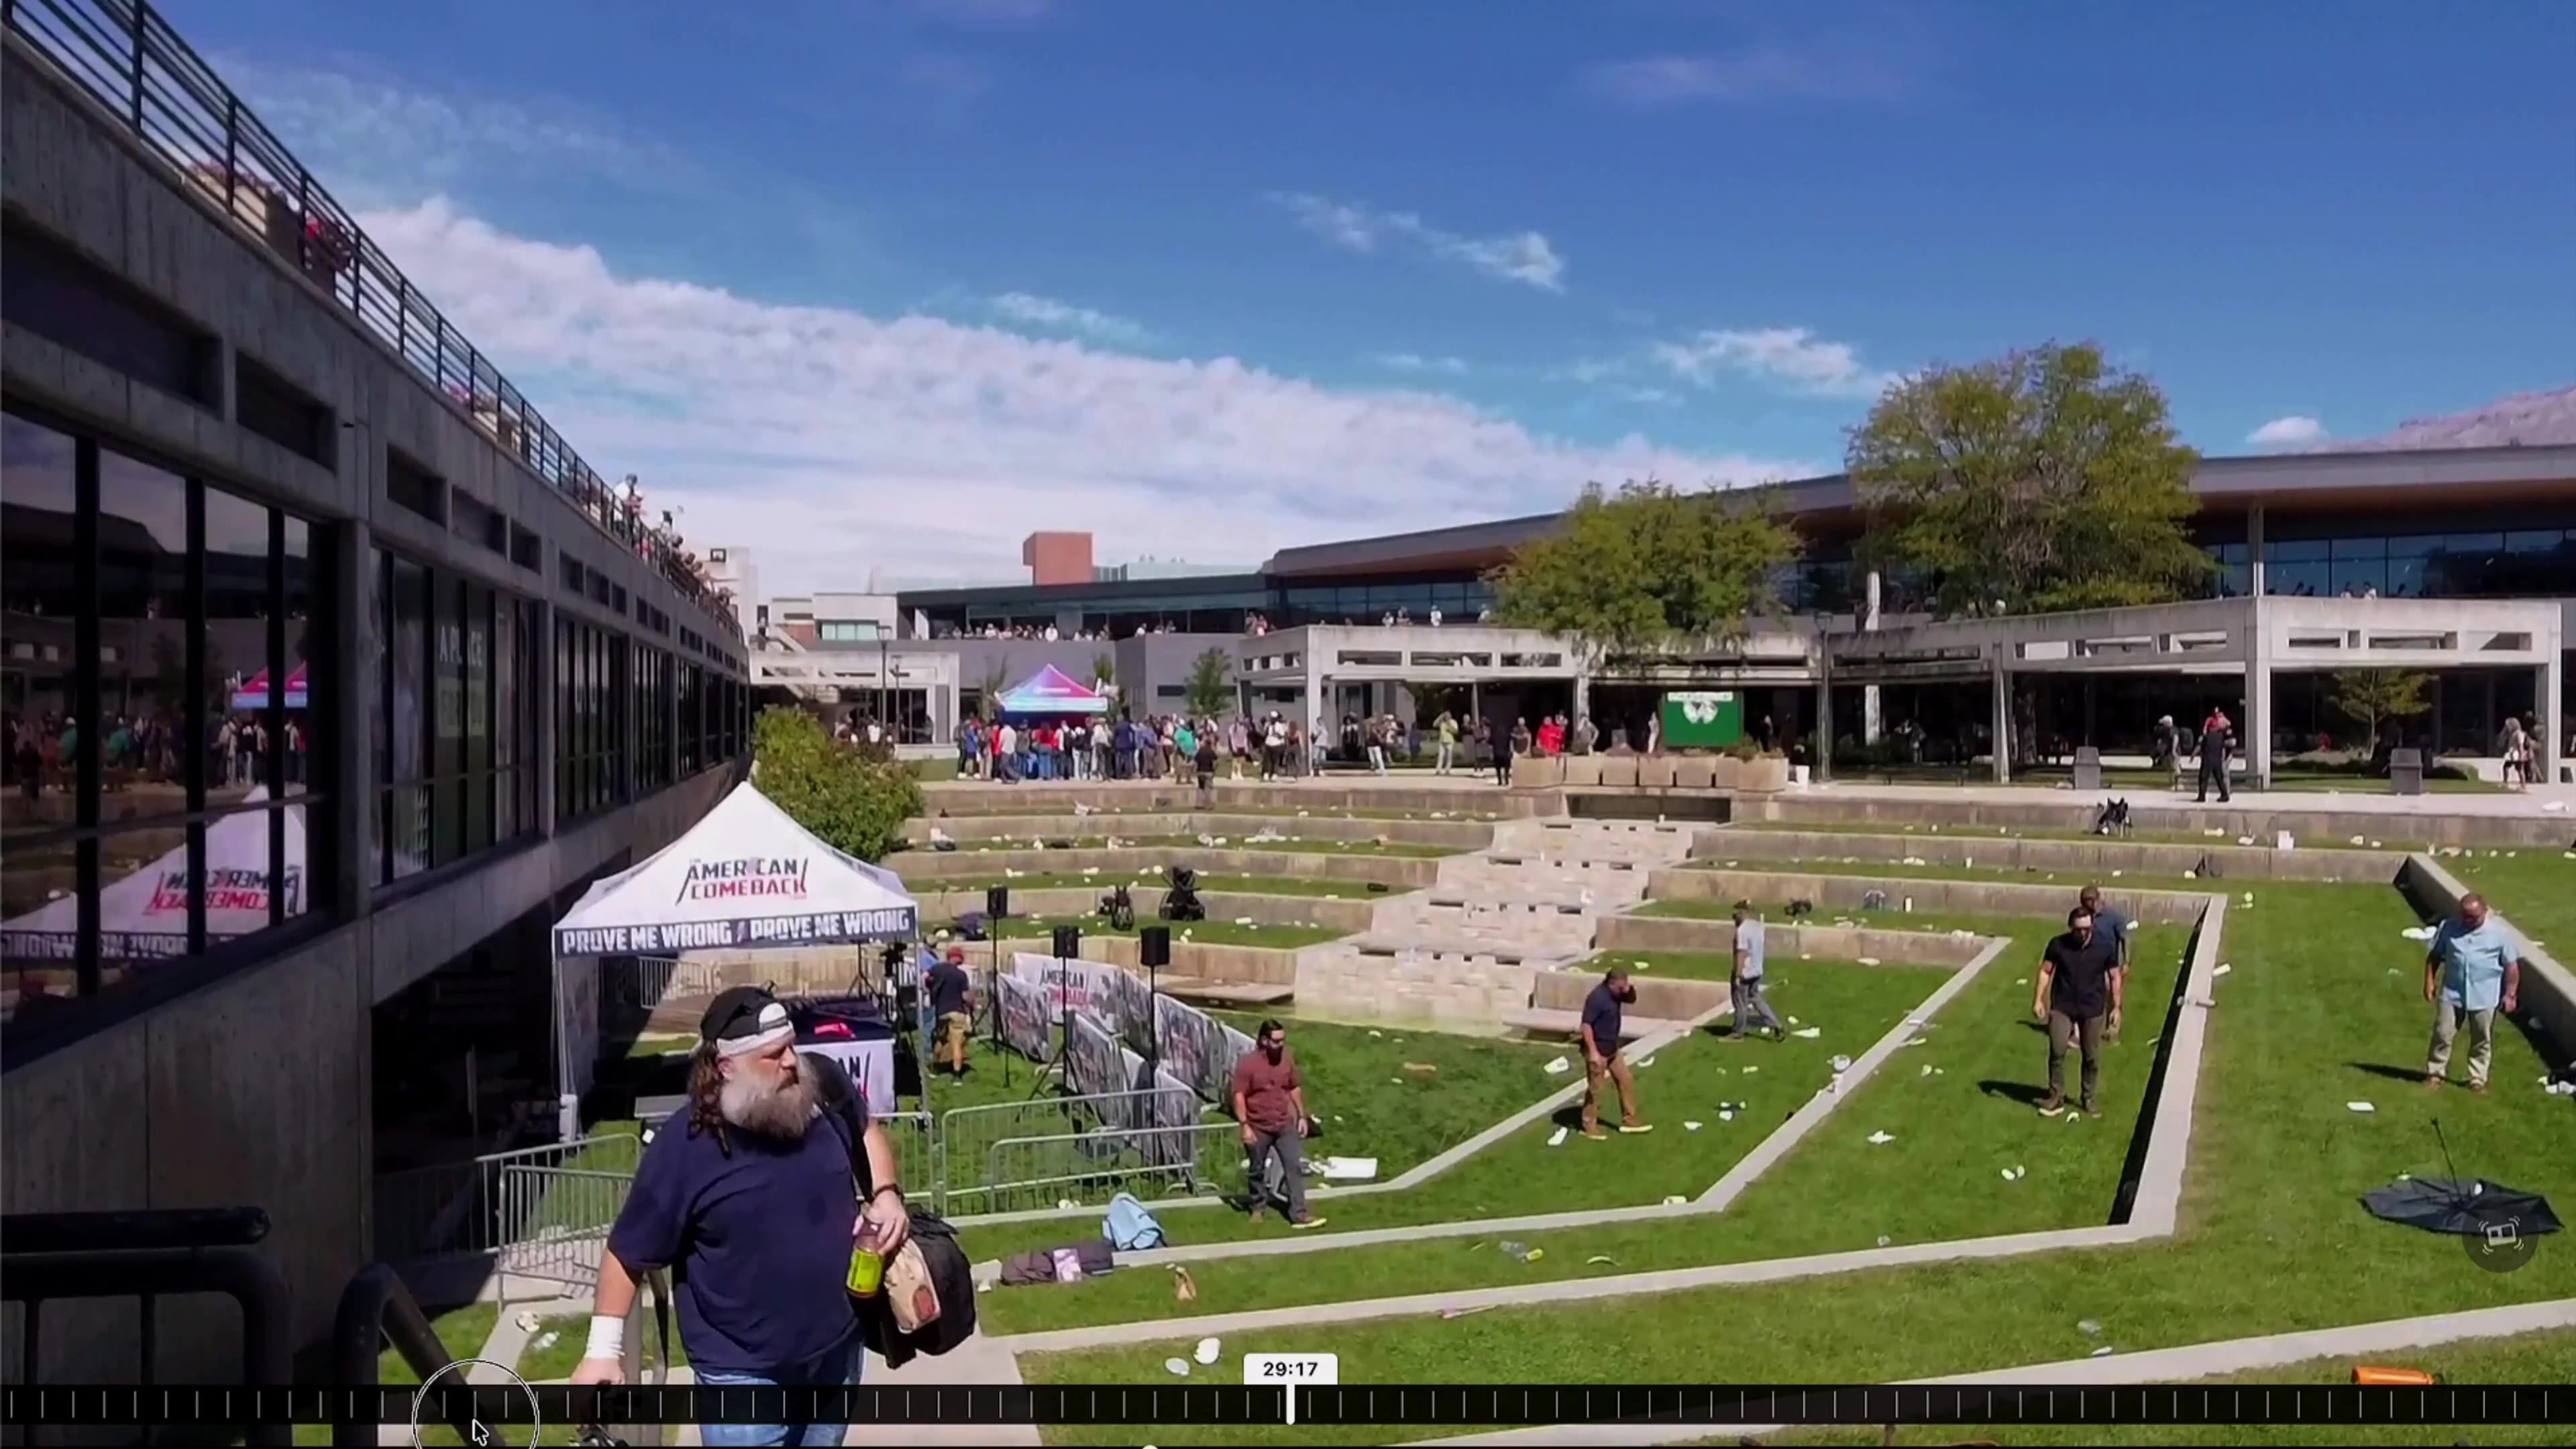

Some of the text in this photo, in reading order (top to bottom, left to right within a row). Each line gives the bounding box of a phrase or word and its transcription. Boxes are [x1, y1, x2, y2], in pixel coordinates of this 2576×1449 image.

[450, 626, 482, 667] PLCE
[690, 875, 808, 900] COMEBACK
[562, 909, 910, 954] PROVE ME WRONG PROVE ME WRONG
